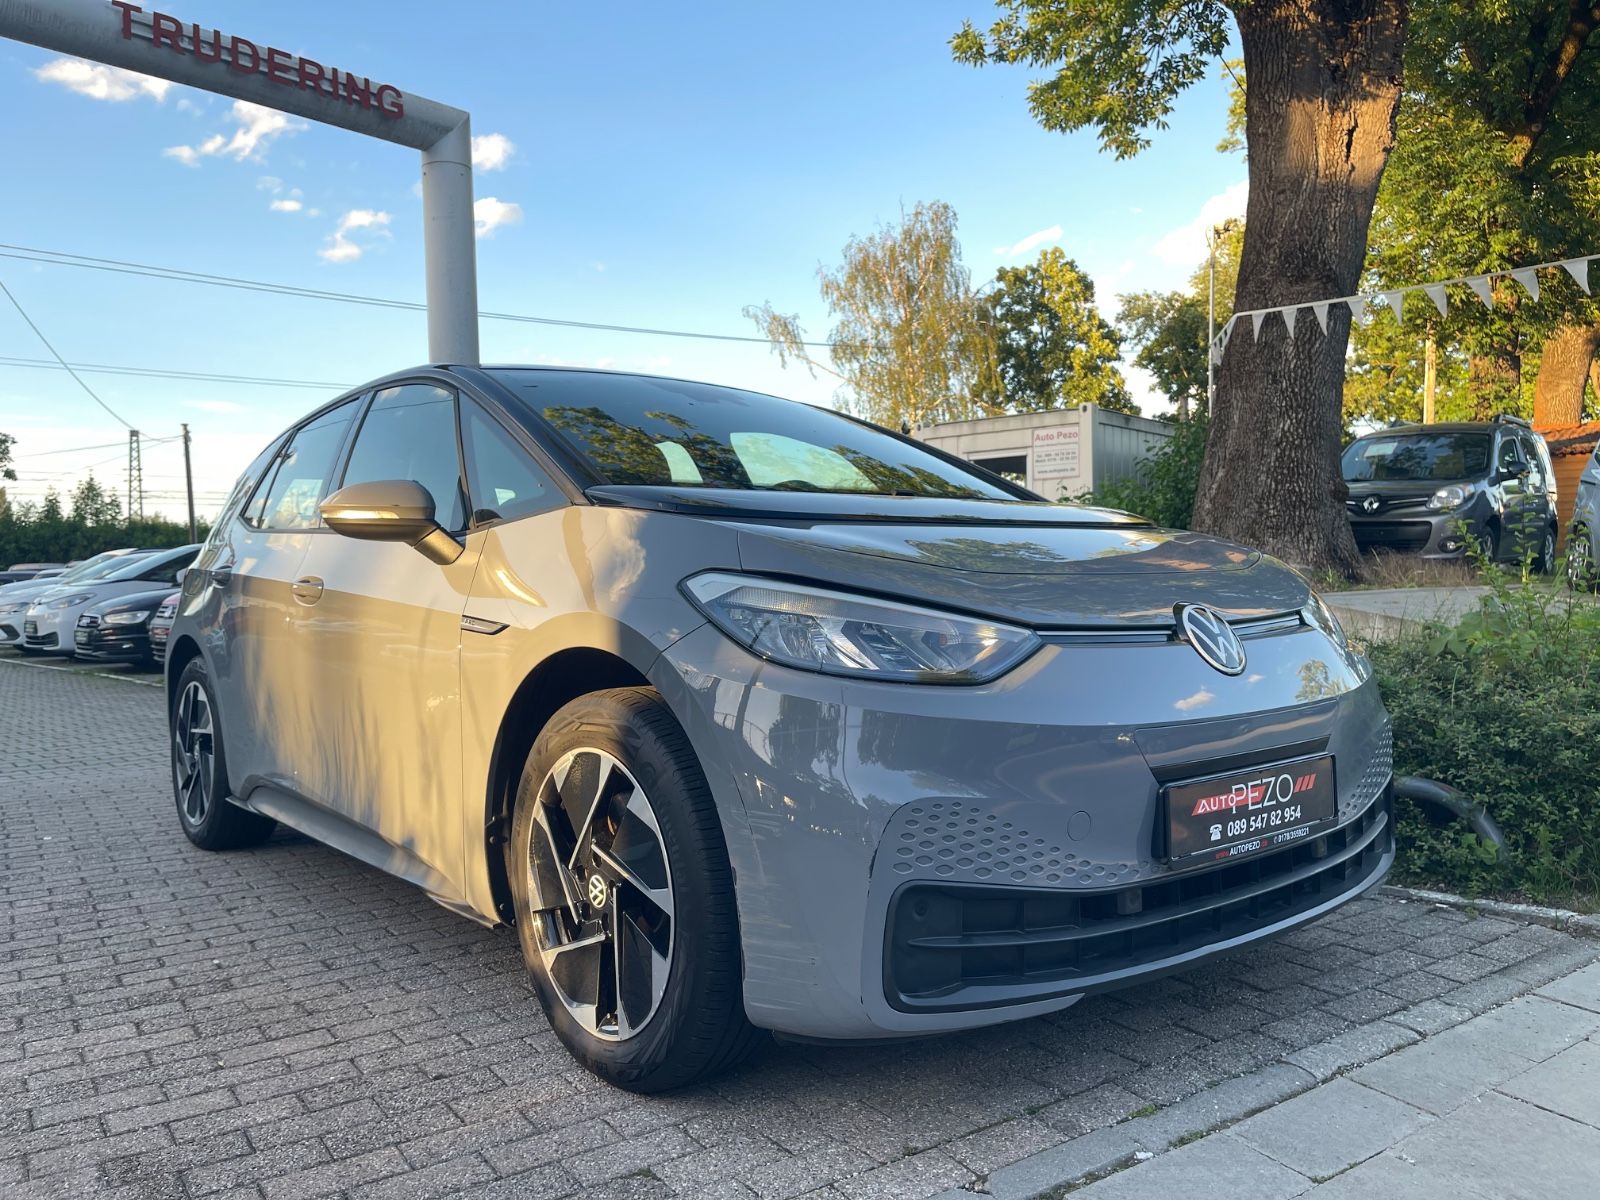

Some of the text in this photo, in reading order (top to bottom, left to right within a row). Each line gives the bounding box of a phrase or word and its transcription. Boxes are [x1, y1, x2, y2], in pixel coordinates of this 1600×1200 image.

[112, 0, 404, 119] TRUDERING
[1035, 431, 1078, 442] Auto Pezo
[1227, 805, 1301, 837] 089 547 82 954
